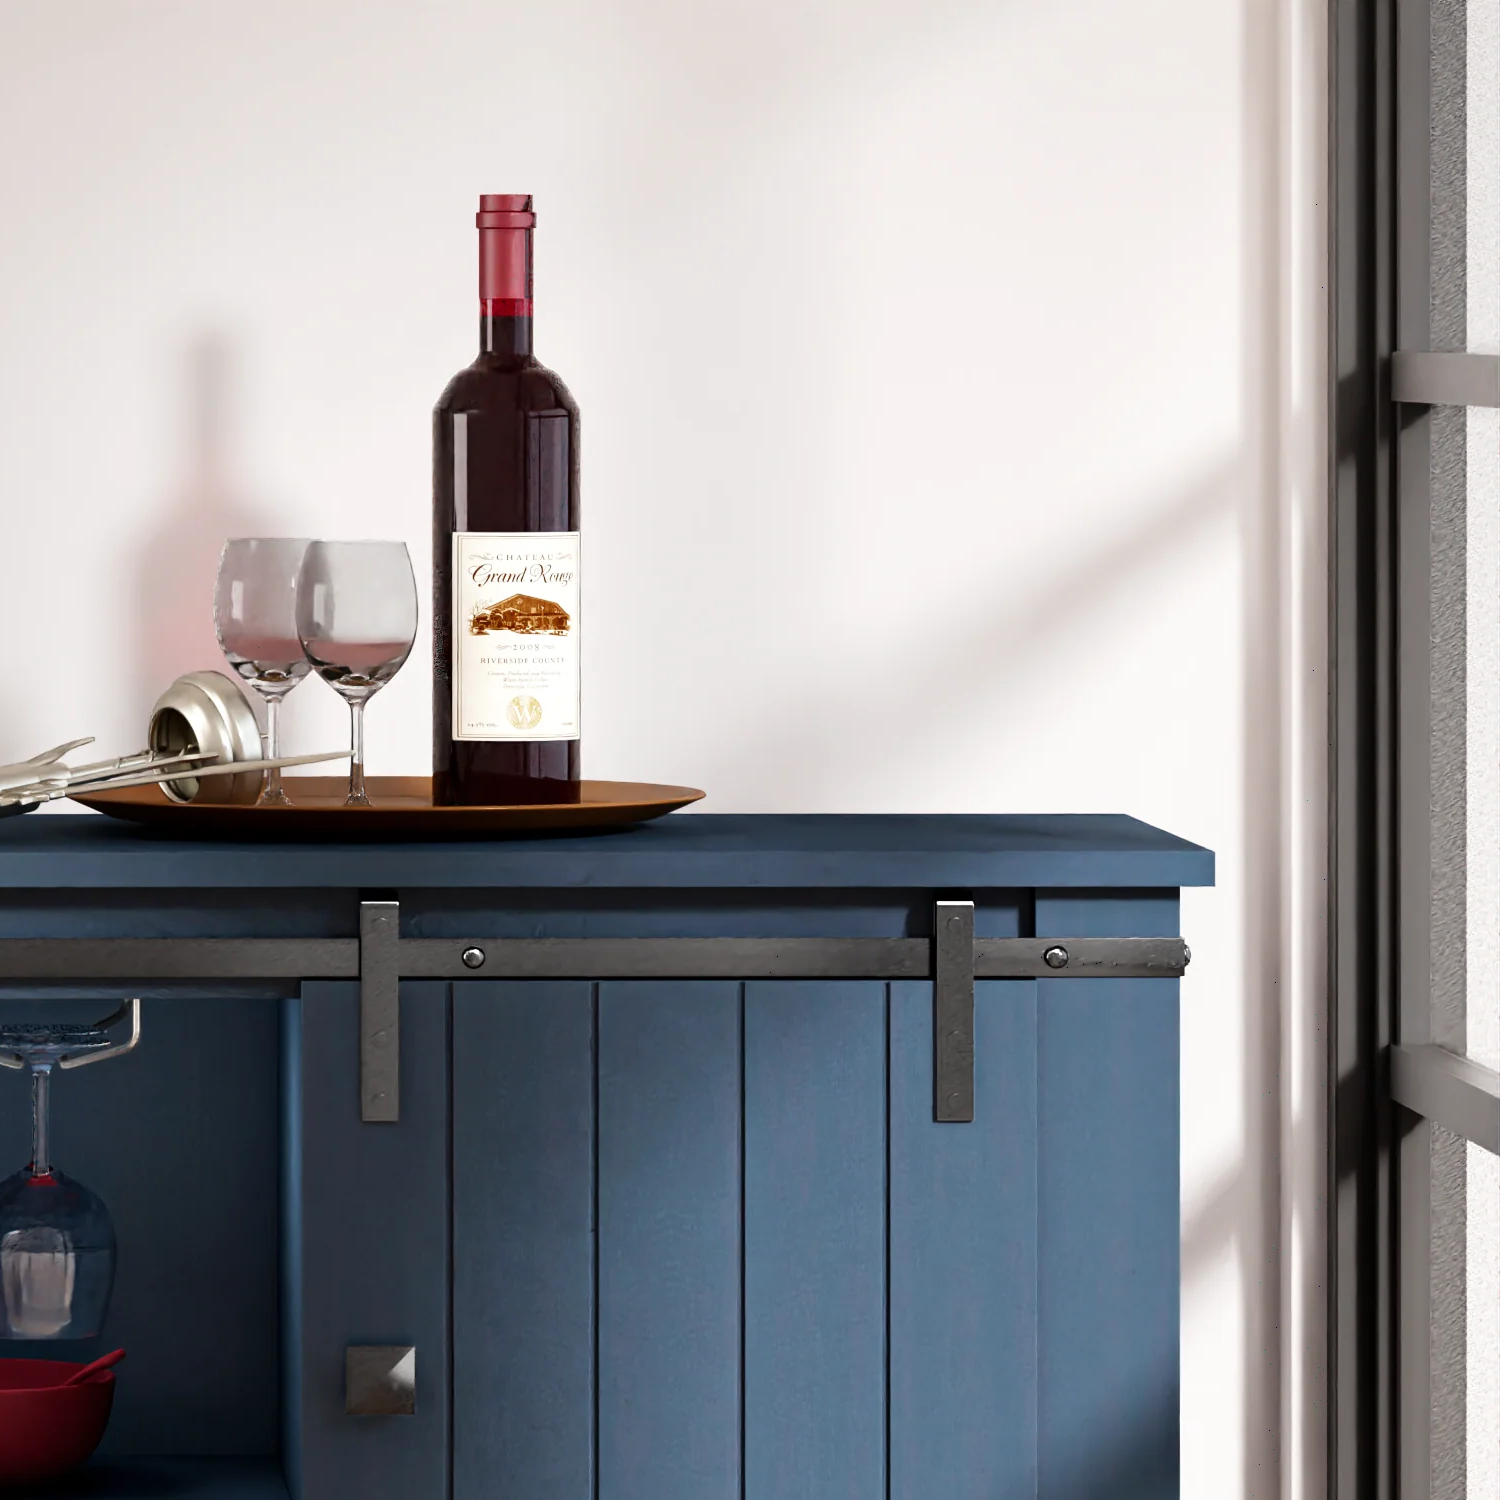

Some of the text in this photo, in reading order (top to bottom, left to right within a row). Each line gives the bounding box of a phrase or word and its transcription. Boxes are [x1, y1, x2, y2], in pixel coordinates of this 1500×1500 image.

[496, 553, 554, 561] CHATEAU
[468, 563, 573, 587] Grand Rouge
